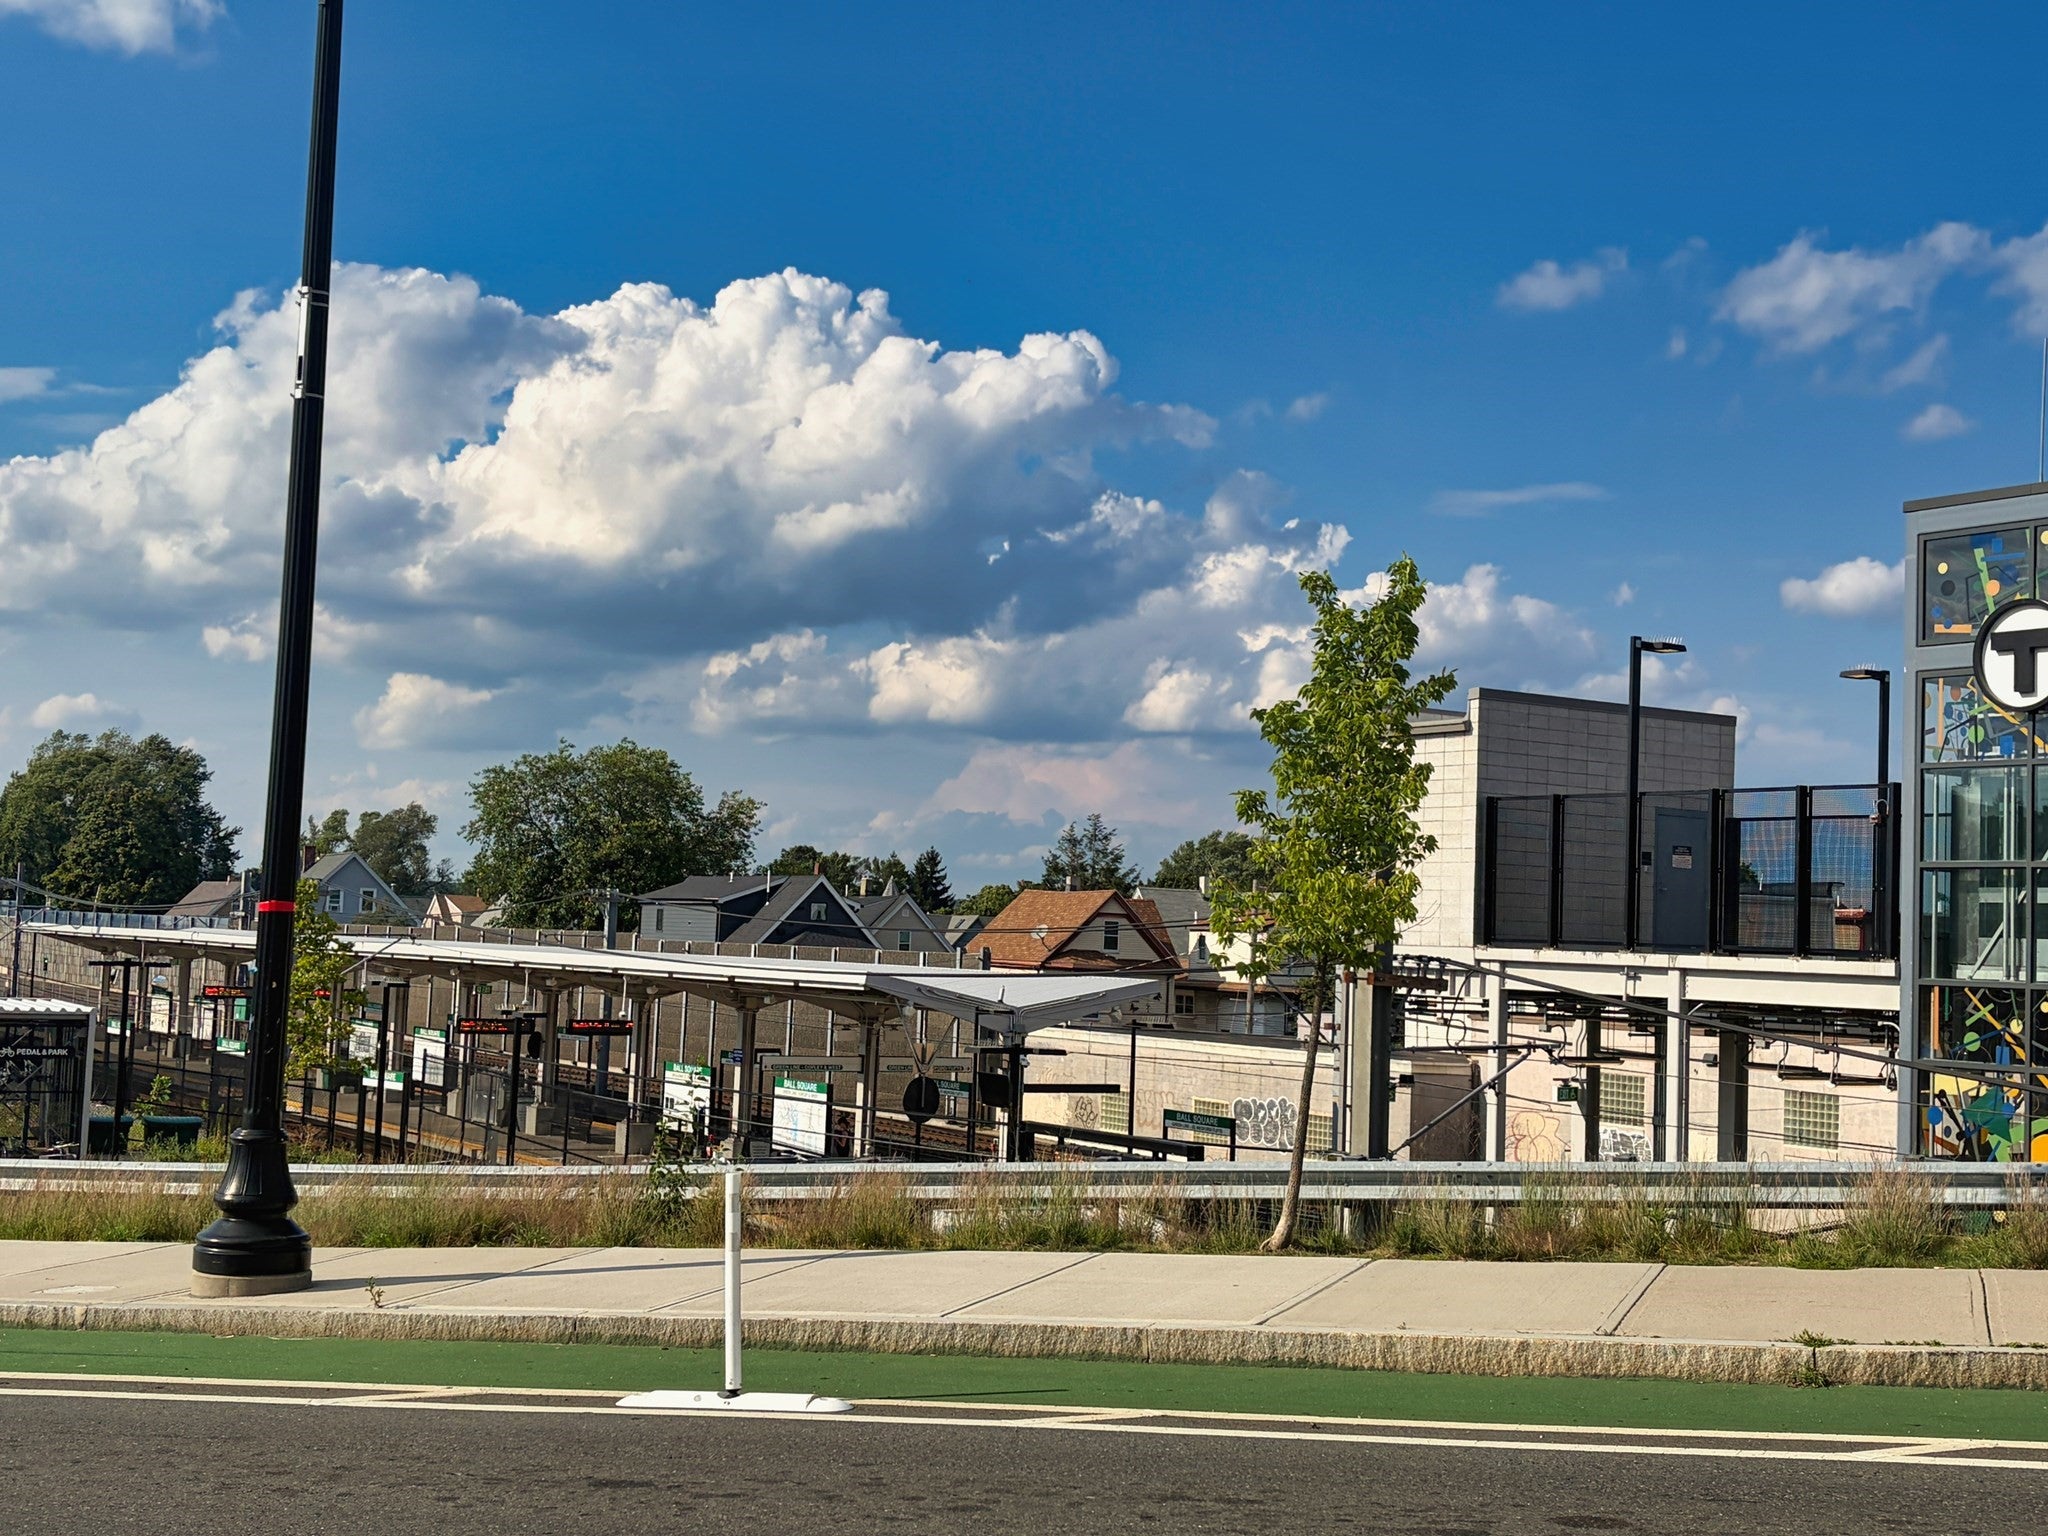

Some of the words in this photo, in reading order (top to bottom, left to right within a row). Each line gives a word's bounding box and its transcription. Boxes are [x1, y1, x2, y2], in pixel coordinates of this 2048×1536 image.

[1991, 627, 2048, 693] T
[16, 1048, 41, 1056] PEDAL
[42, 1048, 47, 1056] &
[48, 1048, 68, 1056] PARK
[784, 1080, 796, 1089] BALL
[797, 1081, 818, 1092] SQUARE
[941, 1080, 959, 1090] SQUARE
[1177, 1112, 1191, 1122] BALL
[1193, 1115, 1218, 1126] SQUARE
